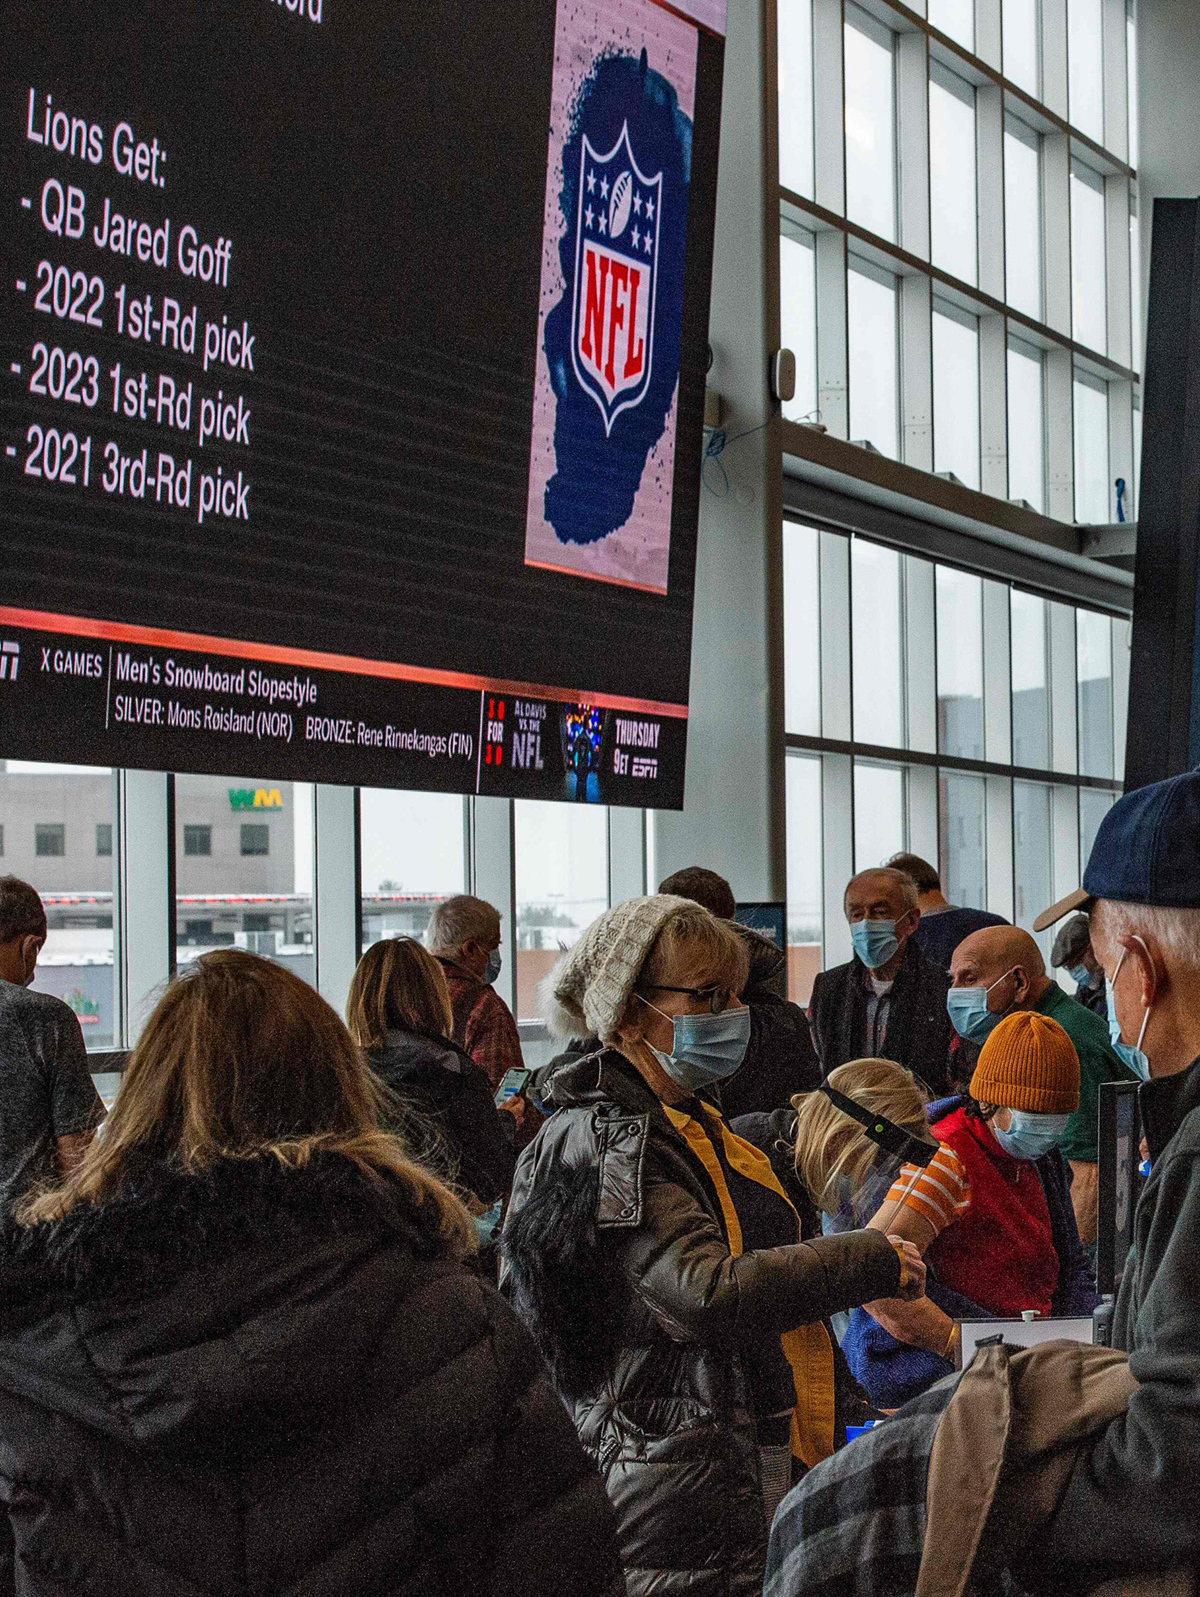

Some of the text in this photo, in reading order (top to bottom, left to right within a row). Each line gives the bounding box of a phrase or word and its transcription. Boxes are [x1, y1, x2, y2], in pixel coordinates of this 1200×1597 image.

[27, 87, 167, 188] Lions Get:
[41, 178, 85, 239] QB
[93, 197, 170, 268] Jared
[178, 225, 232, 287] Goff
[34, 260, 104, 328] 2022
[115, 283, 197, 354] 1st-Rd
[203, 315, 256, 371] pick
[581, 249, 644, 390] NFL
[29, 342, 100, 407] 2023
[110, 362, 193, 430] 1st-Rd
[199, 390, 251, 447] pick
[24, 424, 92, 487] 2021
[102, 441, 192, 507] 3rd-Rd
[198, 466, 250, 523] pick
[41, 647, 51, 672] X
[54, 649, 103, 677] GAMES
[116, 653, 318, 707] Men's Snowboard Slopestyle
[115, 696, 164, 724] SILVER:
[167, 701, 201, 729] Mons
[256, 711, 294, 743] (NOR)
[305, 716, 355, 744] BRONZE:
[357, 722, 383, 747] Rene
[385, 725, 447, 757] Rinnekangas
[448, 732, 473, 760] (FIN)
[487, 720, 504, 743] FOR
[511, 732, 544, 770] NFL
[615, 718, 660, 749] THURSDAY
[228, 788, 283, 807] WM
[632, 757, 658, 779] ESPN
